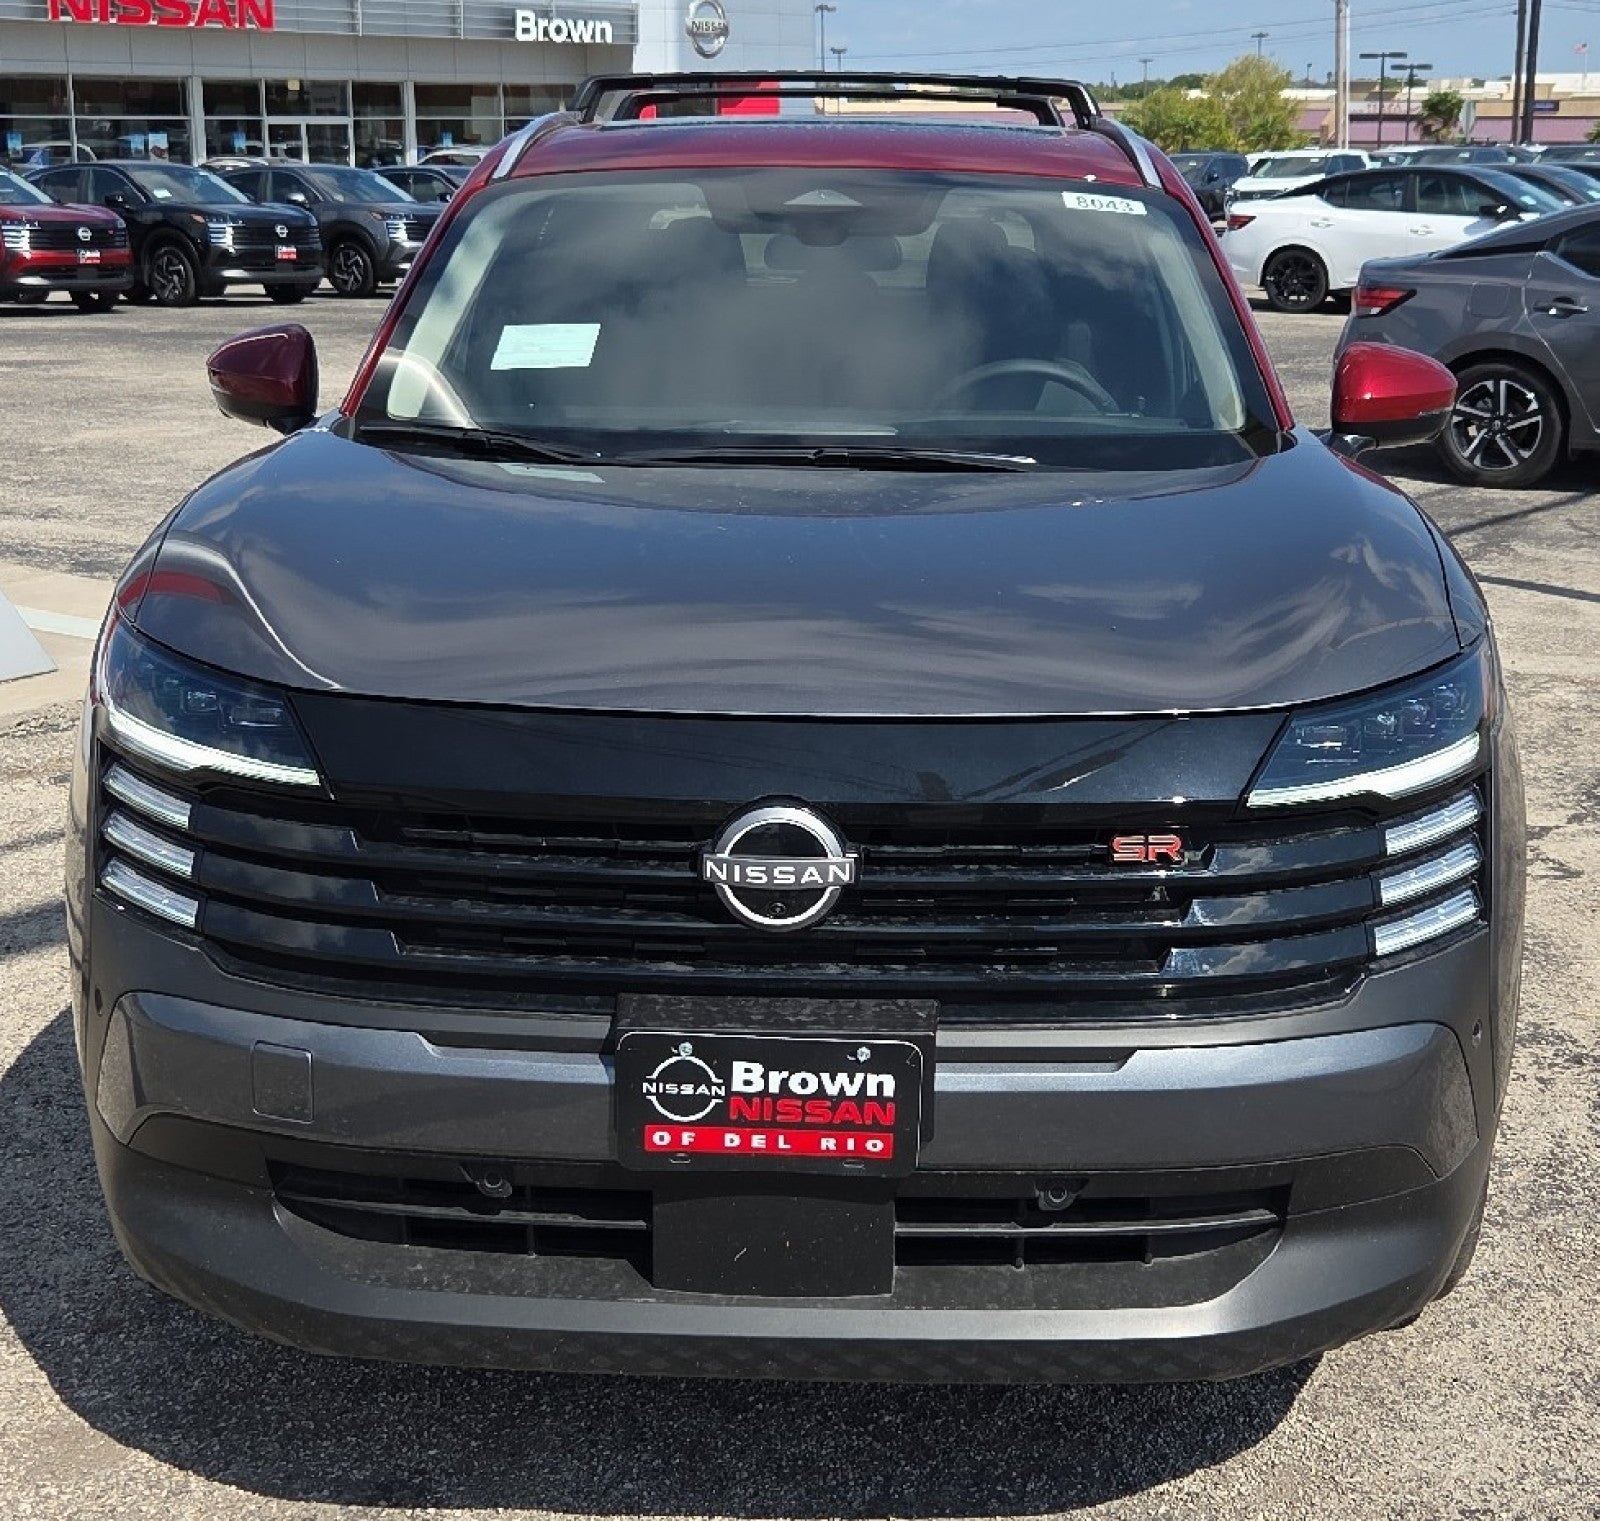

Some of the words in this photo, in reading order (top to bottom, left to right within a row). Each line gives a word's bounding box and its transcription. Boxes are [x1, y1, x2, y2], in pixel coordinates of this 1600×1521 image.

[48, 0, 275, 31] NISSAN
[515, 9, 613, 43] Brown
[1076, 195, 1135, 212] 8043
[1112, 835, 1182, 861] SR
[706, 860, 850, 884] NISSAN
[642, 1081, 726, 1097] NISSAN
[731, 1060, 896, 1098] Brown
[729, 1096, 896, 1126] NISSAN
[652, 1131, 696, 1146] OF
[724, 1133, 792, 1149] DEL
[820, 1137, 885, 1153] RIO
